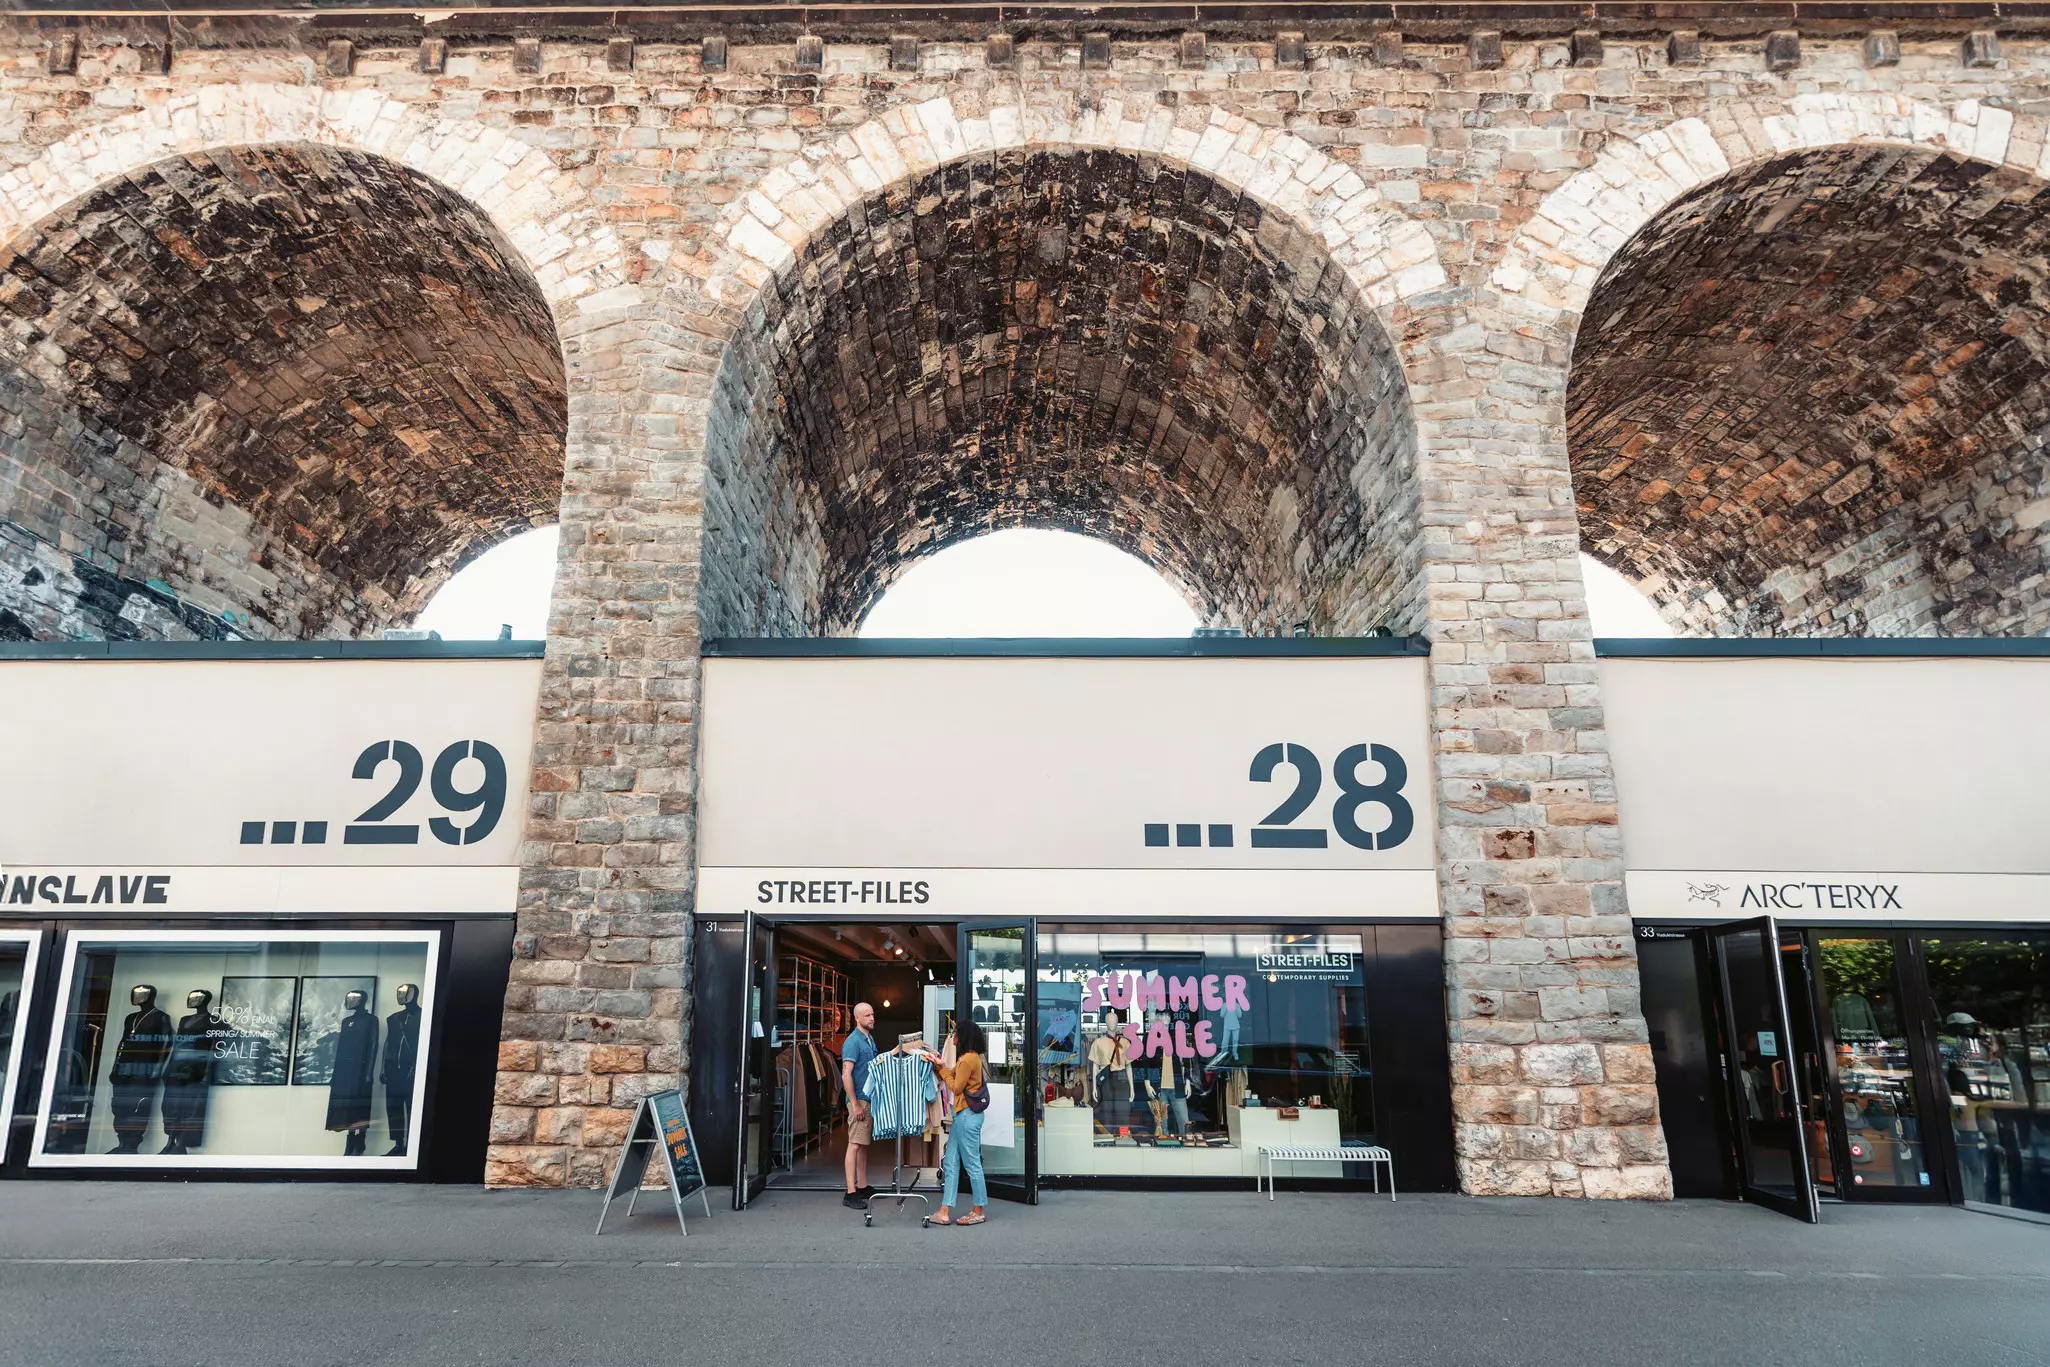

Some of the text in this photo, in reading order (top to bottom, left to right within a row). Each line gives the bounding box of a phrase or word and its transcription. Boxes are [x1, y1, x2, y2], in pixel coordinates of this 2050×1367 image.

[757, 880, 930, 904] STREET-FILES
[1739, 882, 1903, 909] ARC'TERYX
[706, 921, 717, 932] 31
[1640, 926, 1655, 938] 33
[1261, 954, 1348, 967] STREET-FILES
[1082, 974, 1250, 1012] SUMMER
[209, 1006, 275, 1025] 50% FINAL
[213, 1040, 261, 1059] SALE
[1123, 1020, 1217, 1060] SALE
